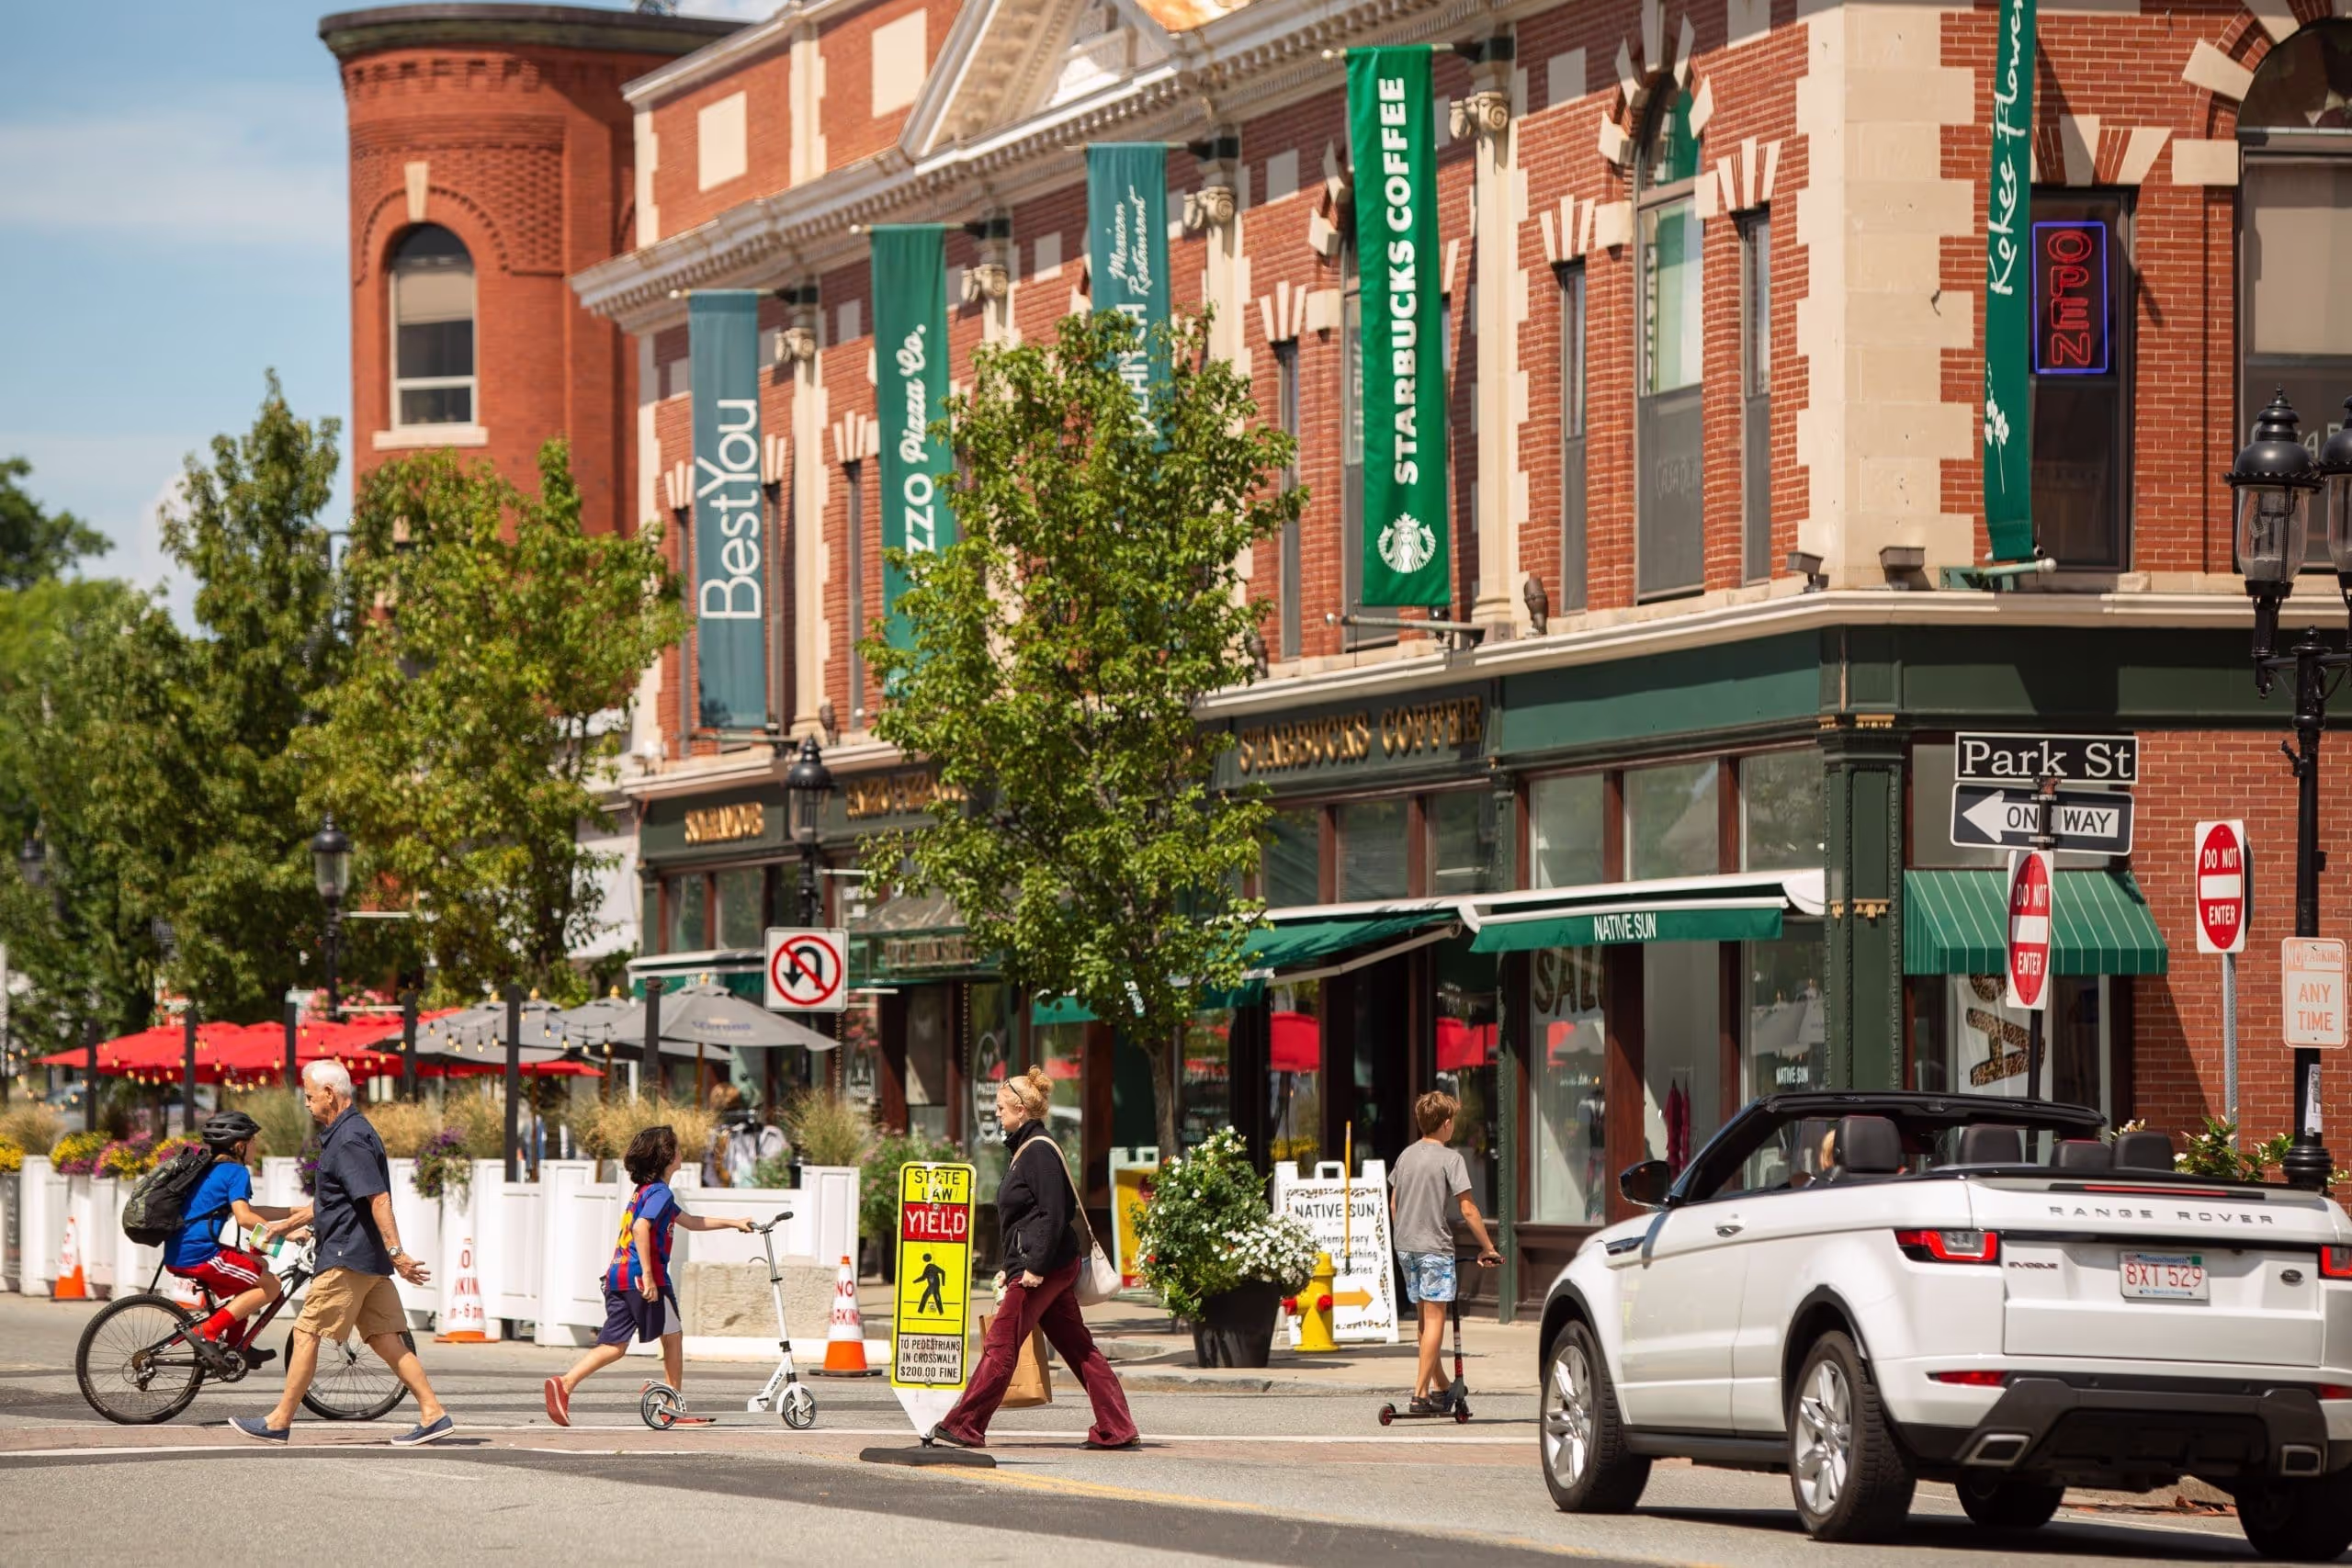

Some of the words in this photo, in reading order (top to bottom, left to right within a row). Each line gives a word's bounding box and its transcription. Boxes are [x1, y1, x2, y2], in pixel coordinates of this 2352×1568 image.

[1379, 77, 1412, 232] COFFEE
[1988, 153, 2018, 295] Kokee
[1105, 200, 1128, 279] Mexican
[1127, 185, 1153, 296] Restaurant
[2048, 231, 2092, 366] OPEN
[896, 323, 927, 377] Co.
[1388, 240, 1418, 485] STARBUCKS
[899, 378, 929, 464] Pizza
[695, 399, 763, 620] BestYou
[1380, 696, 1482, 756] COFFEE
[1962, 740, 2068, 776] Park
[2085, 742, 2132, 778] St
[2007, 806, 2054, 830] ON
[2064, 808, 2112, 835] WAY
[2205, 848, 2218, 869] DO
[2222, 847, 2237, 868] NOT
[2016, 885, 2029, 908] DO
[2033, 883, 2048, 906] NOT
[1594, 913, 1634, 942] NATIVE
[1635, 911, 1657, 940] SUN
[2209, 905, 2236, 927] ENTER
[2018, 952, 2041, 976] ENTER
[2304, 949, 2341, 964] PARKING
[2299, 983, 2332, 1004] ANY
[2298, 1011, 2334, 1032] TIME
[1776, 1066, 1795, 1086] NATIVE
[1797, 1066, 1809, 1083] SUN
[914, 1170, 961, 1185] STATE
[922, 1188, 953, 1201] LAW
[1295, 1203, 1343, 1218] NATIVE
[1348, 1202, 1375, 1217] SUN
[2049, 1205, 2154, 1219] RANGE
[2177, 1211, 2275, 1224] ROVER
[907, 1211, 966, 1235] YIELD
[2126, 1263, 2161, 1287] 8XT
[2168, 1264, 2202, 1288] 529
[834, 1280, 854, 1297] NO
[900, 1339, 910, 1349] TO
[911, 1338, 961, 1352] PEDESTRIANS
[903, 1352, 911, 1362] IN
[913, 1353, 956, 1364] CROSSWALK
[900, 1366, 936, 1378] $200.00
[939, 1367, 958, 1378] FINE
